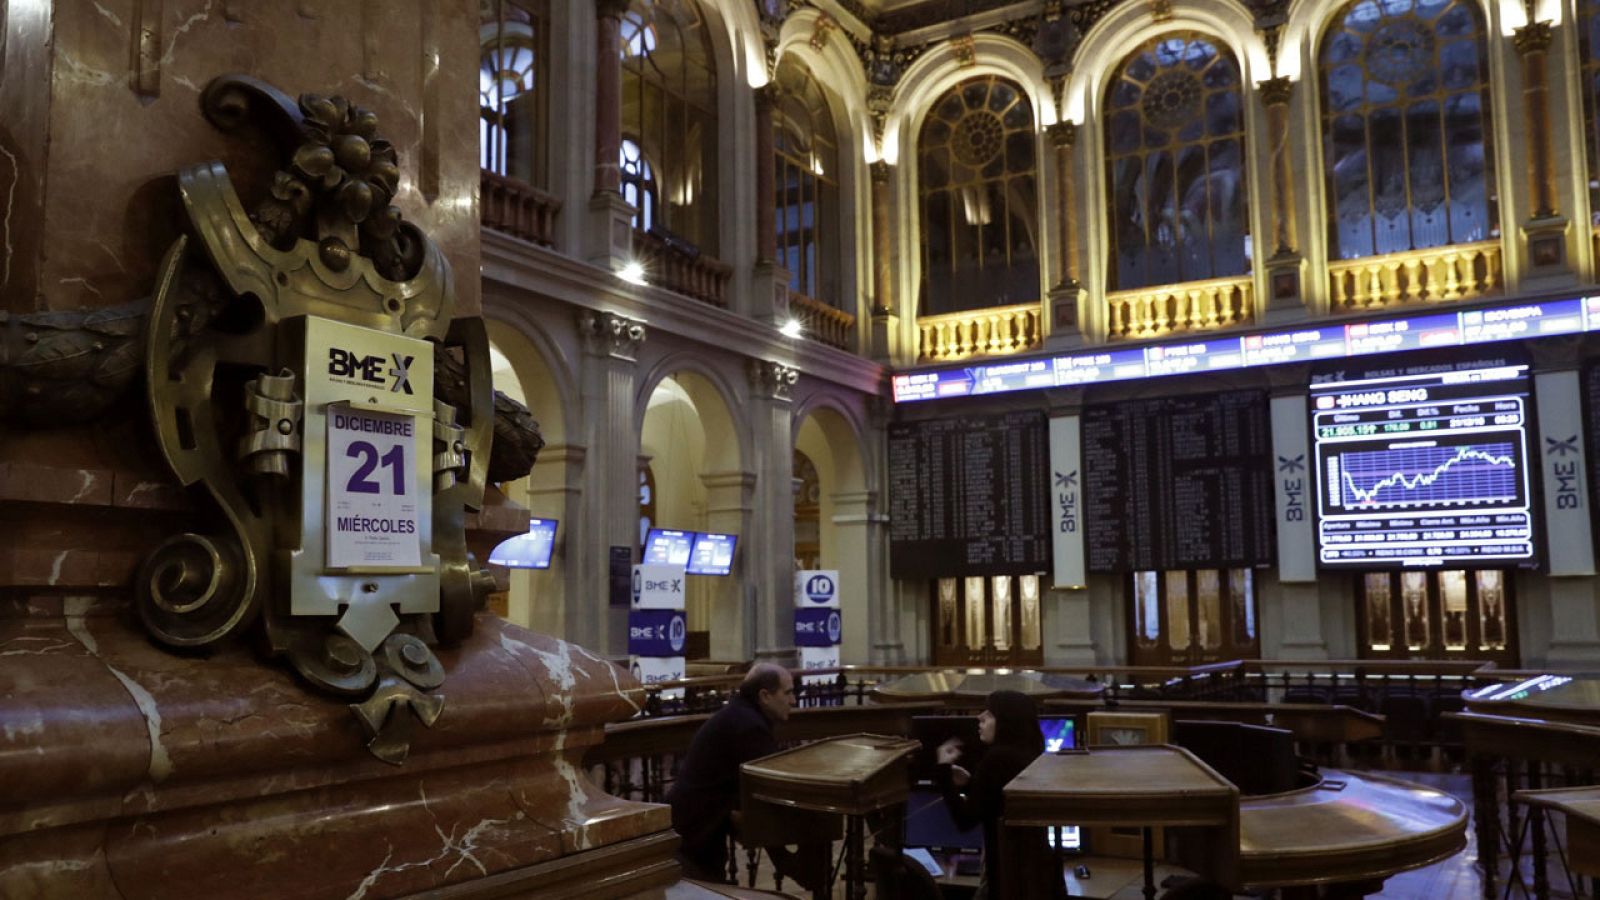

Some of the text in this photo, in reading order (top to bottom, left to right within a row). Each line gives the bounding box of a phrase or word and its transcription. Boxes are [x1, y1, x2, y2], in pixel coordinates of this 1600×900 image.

[329, 348, 386, 384] BME
[1364, 368, 1396, 378] BOLSAS
[335, 415, 412, 437] DICIEMBRE
[346, 441, 405, 495] 21
[1554, 461, 1578, 509] BME
[1060, 492, 1075, 532] BME
[1284, 478, 1303, 522] BME
[337, 514, 415, 534] MIÉRCOLES
[811, 578, 831, 594] 10
